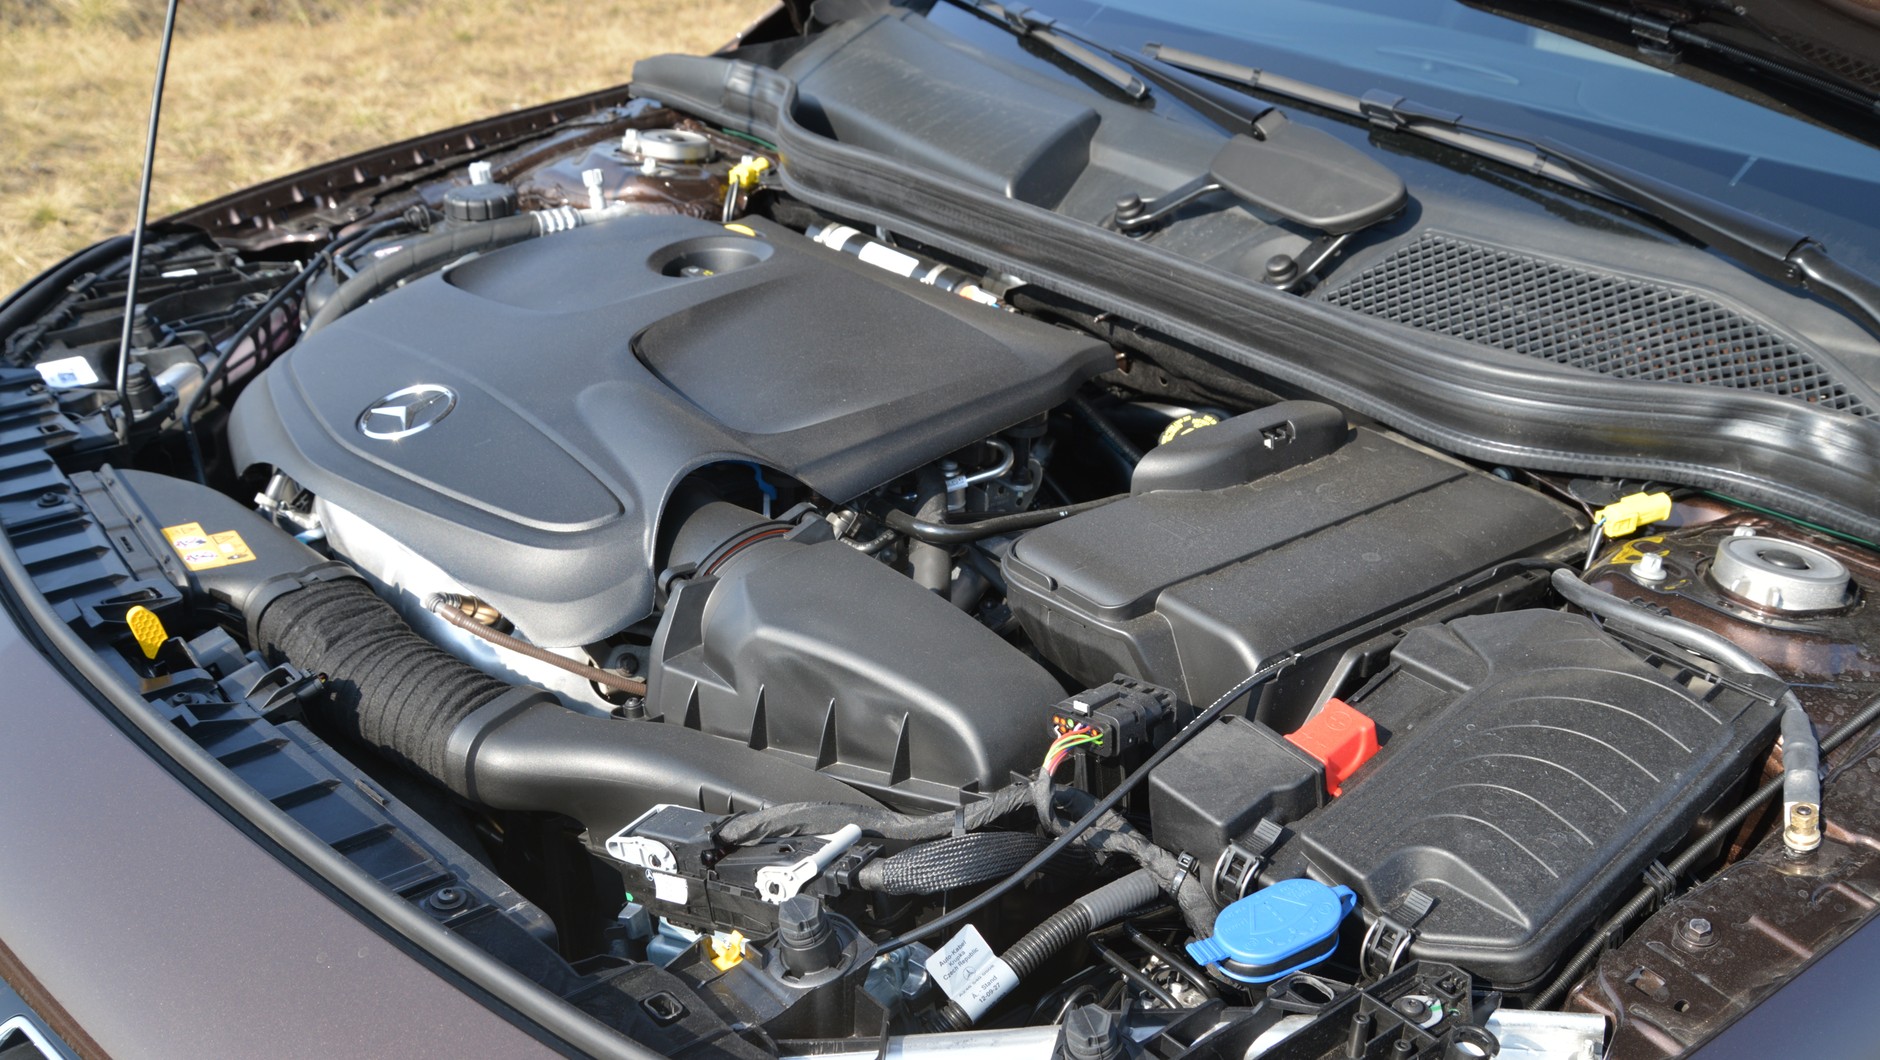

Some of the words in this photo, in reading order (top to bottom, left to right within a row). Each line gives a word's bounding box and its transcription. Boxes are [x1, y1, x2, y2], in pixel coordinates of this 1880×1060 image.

[939, 939, 967, 967] Auto-Kabel
[943, 966, 959, 981] Czech
[957, 947, 979, 967] Republic
[981, 975, 998, 991] Stand
